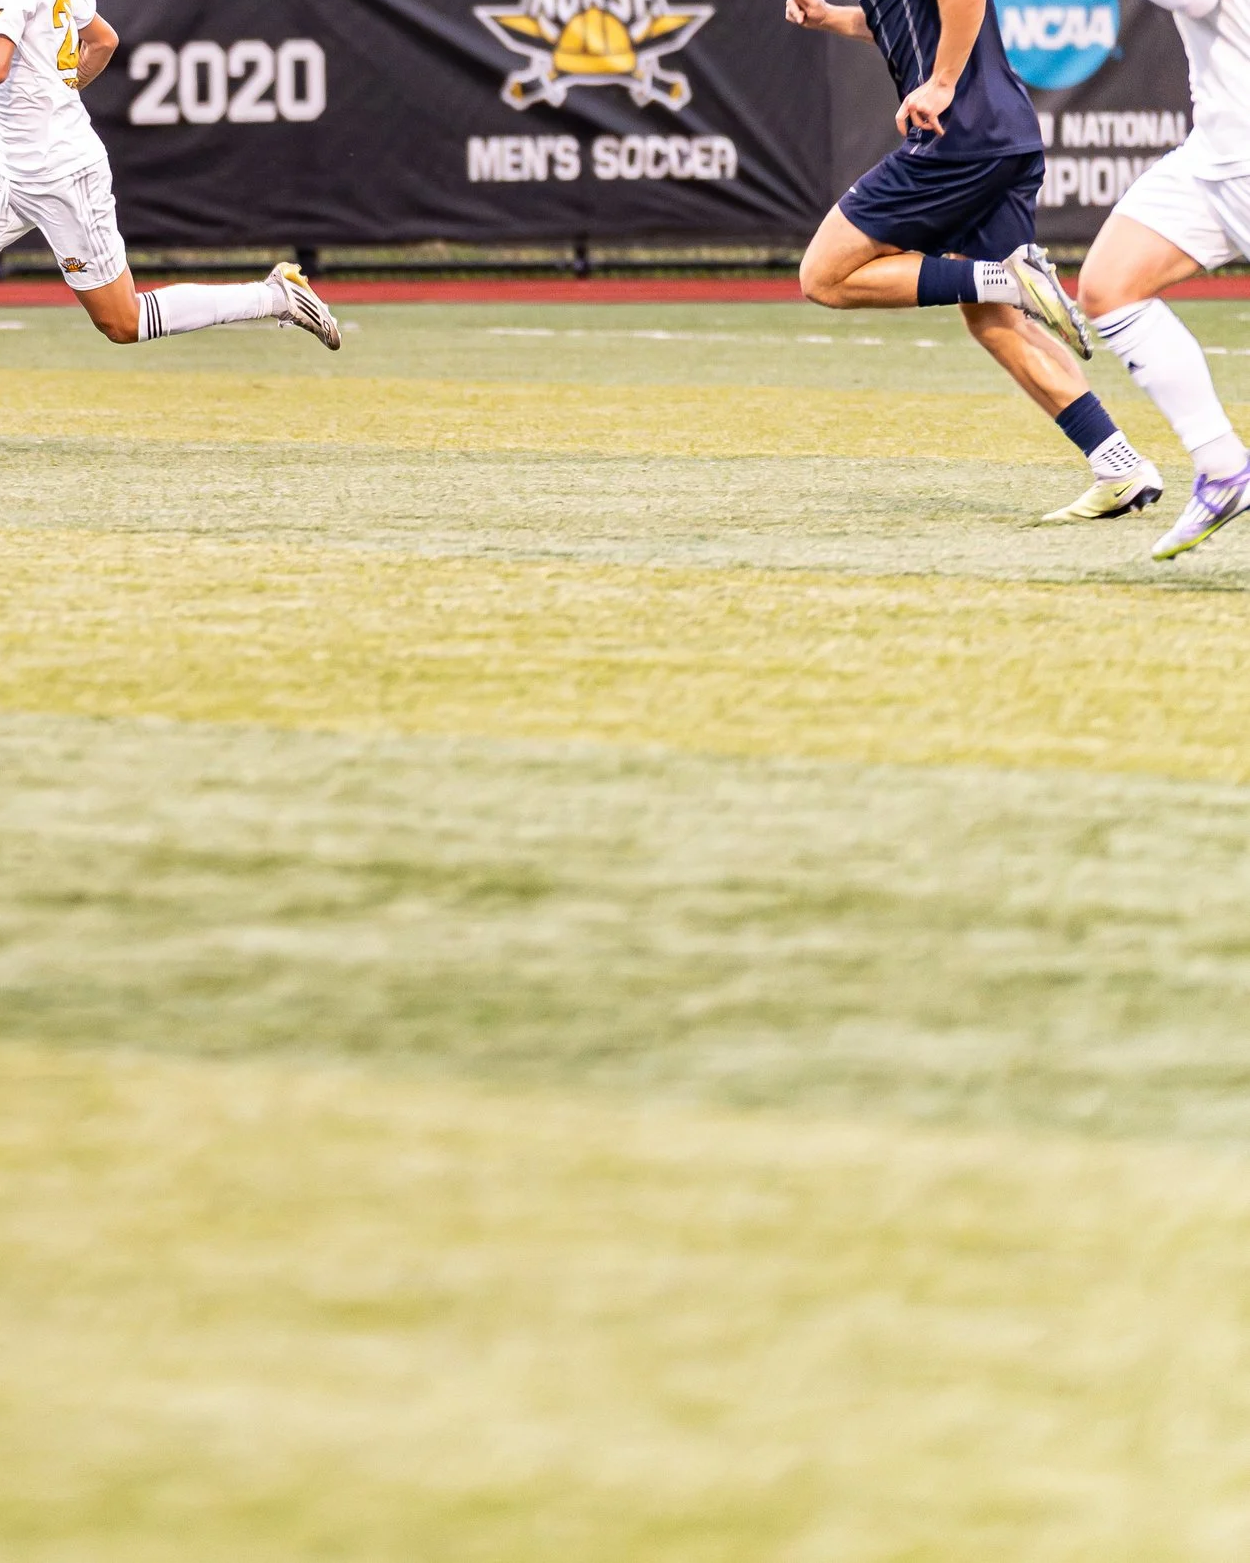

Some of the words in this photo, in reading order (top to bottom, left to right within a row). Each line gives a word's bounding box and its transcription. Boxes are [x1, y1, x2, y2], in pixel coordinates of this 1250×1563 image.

[1001, 6, 1115, 50] NCAA
[129, 39, 327, 124] 2020
[467, 134, 581, 182] MEN'S
[592, 134, 738, 181] SOCCER
